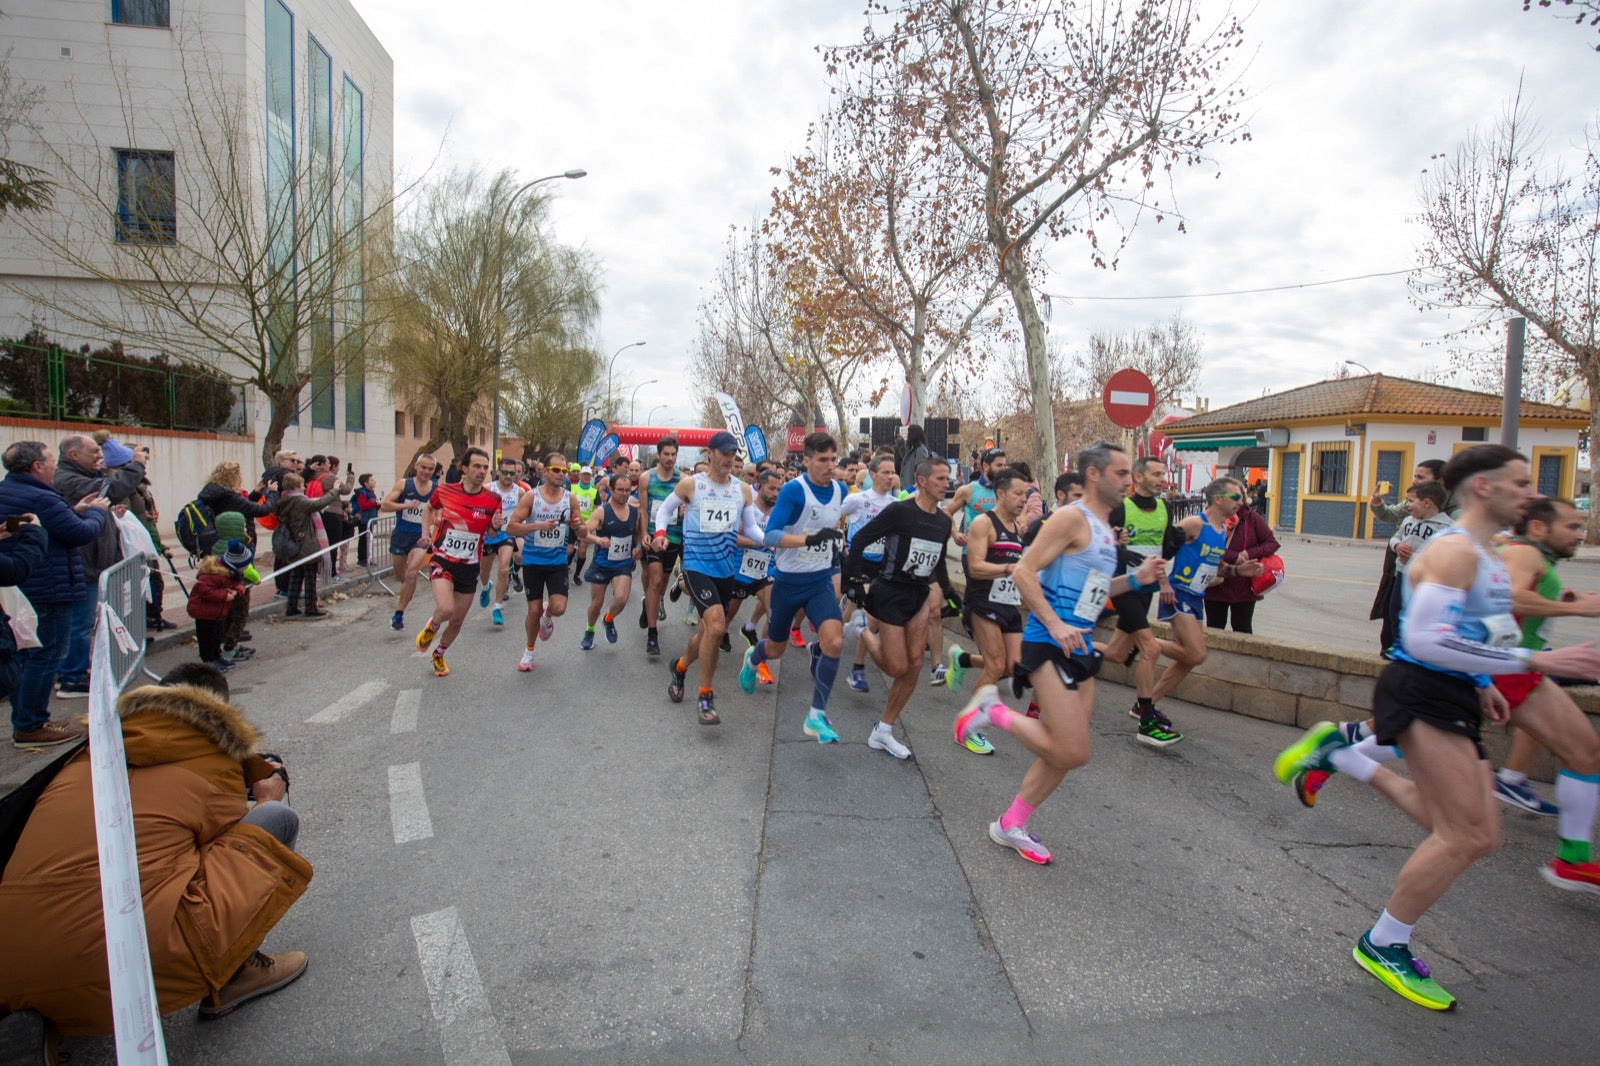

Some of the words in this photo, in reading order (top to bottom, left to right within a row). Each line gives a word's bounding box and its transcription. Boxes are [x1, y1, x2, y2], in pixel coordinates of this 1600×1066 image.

[706, 509, 730, 522] 741
[539, 529, 560, 539] 669
[1404, 522, 1434, 540] GAP
[446, 537, 476, 552] 3010
[747, 558, 766, 571] 670
[910, 551, 938, 567] 3018
